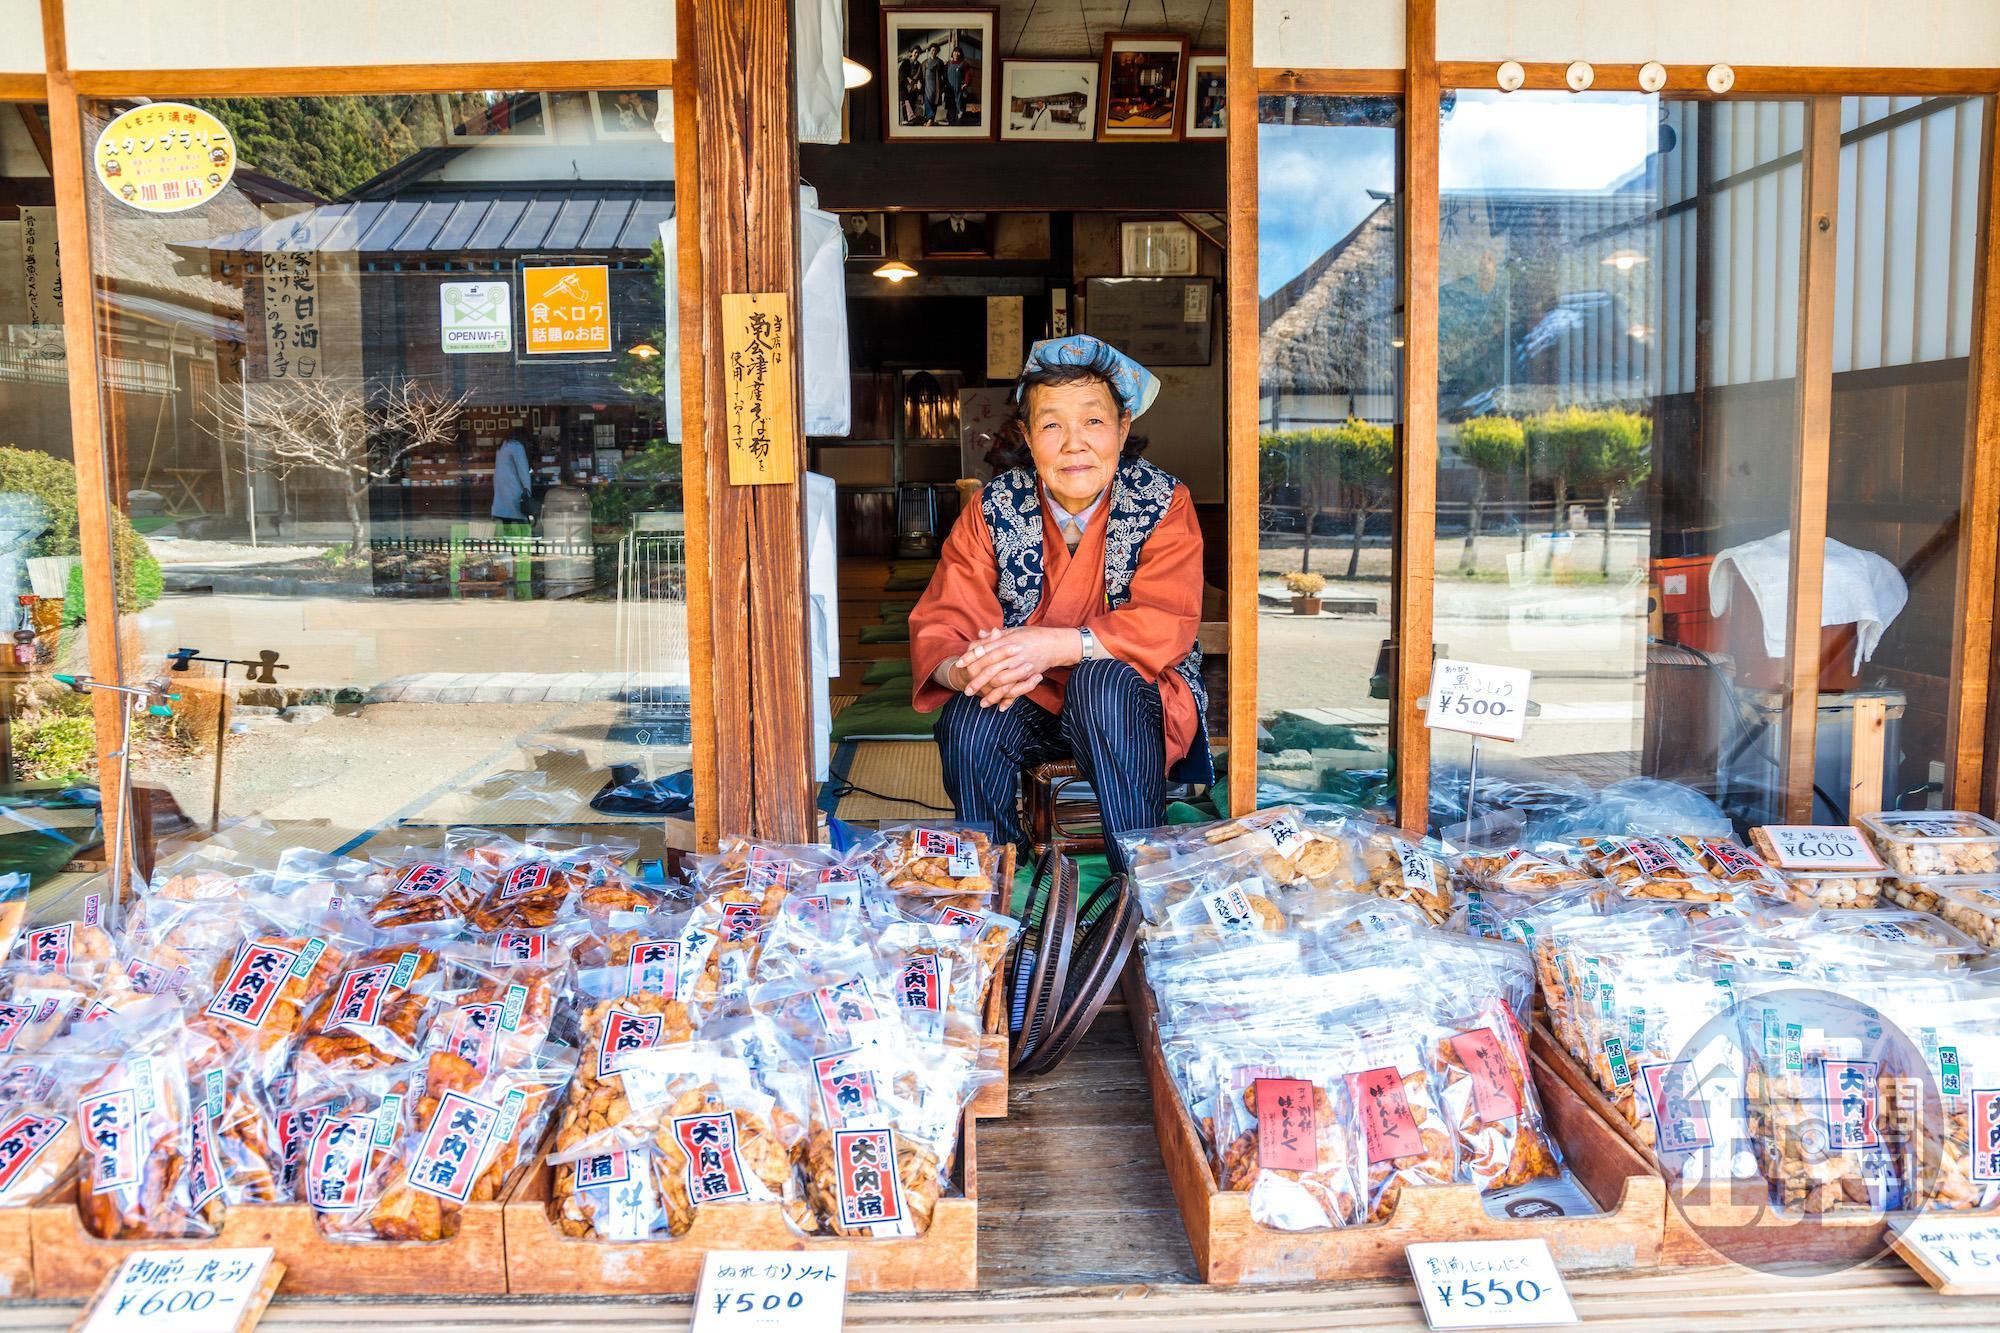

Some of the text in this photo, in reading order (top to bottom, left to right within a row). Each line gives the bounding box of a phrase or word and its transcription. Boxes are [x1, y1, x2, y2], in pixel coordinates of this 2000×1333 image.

[105, 129, 226, 156] スタンプラリー
[141, 180, 203, 201] 加盟店
[531, 302, 604, 324] 食べログ
[532, 327, 605, 343] 話題のお店
[448, 331, 477, 341] OPEN
[227, 953, 278, 1017] 大内宿
[341, 971, 377, 1021] 大内宿
[1608, 1043, 1628, 1082] 堅焼
[1942, 1052, 1959, 1089] 堅焼
[1839, 1067, 1867, 1142] 大内宿
[92, 1103, 118, 1180] 大内宿
[320, 1123, 356, 1201] 大内宿
[428, 1107, 479, 1188] 大内宿
[692, 1122, 729, 1195] 大内宿
[851, 1138, 883, 1217] 大内宿
[713, 1291, 804, 1314] ¥500
